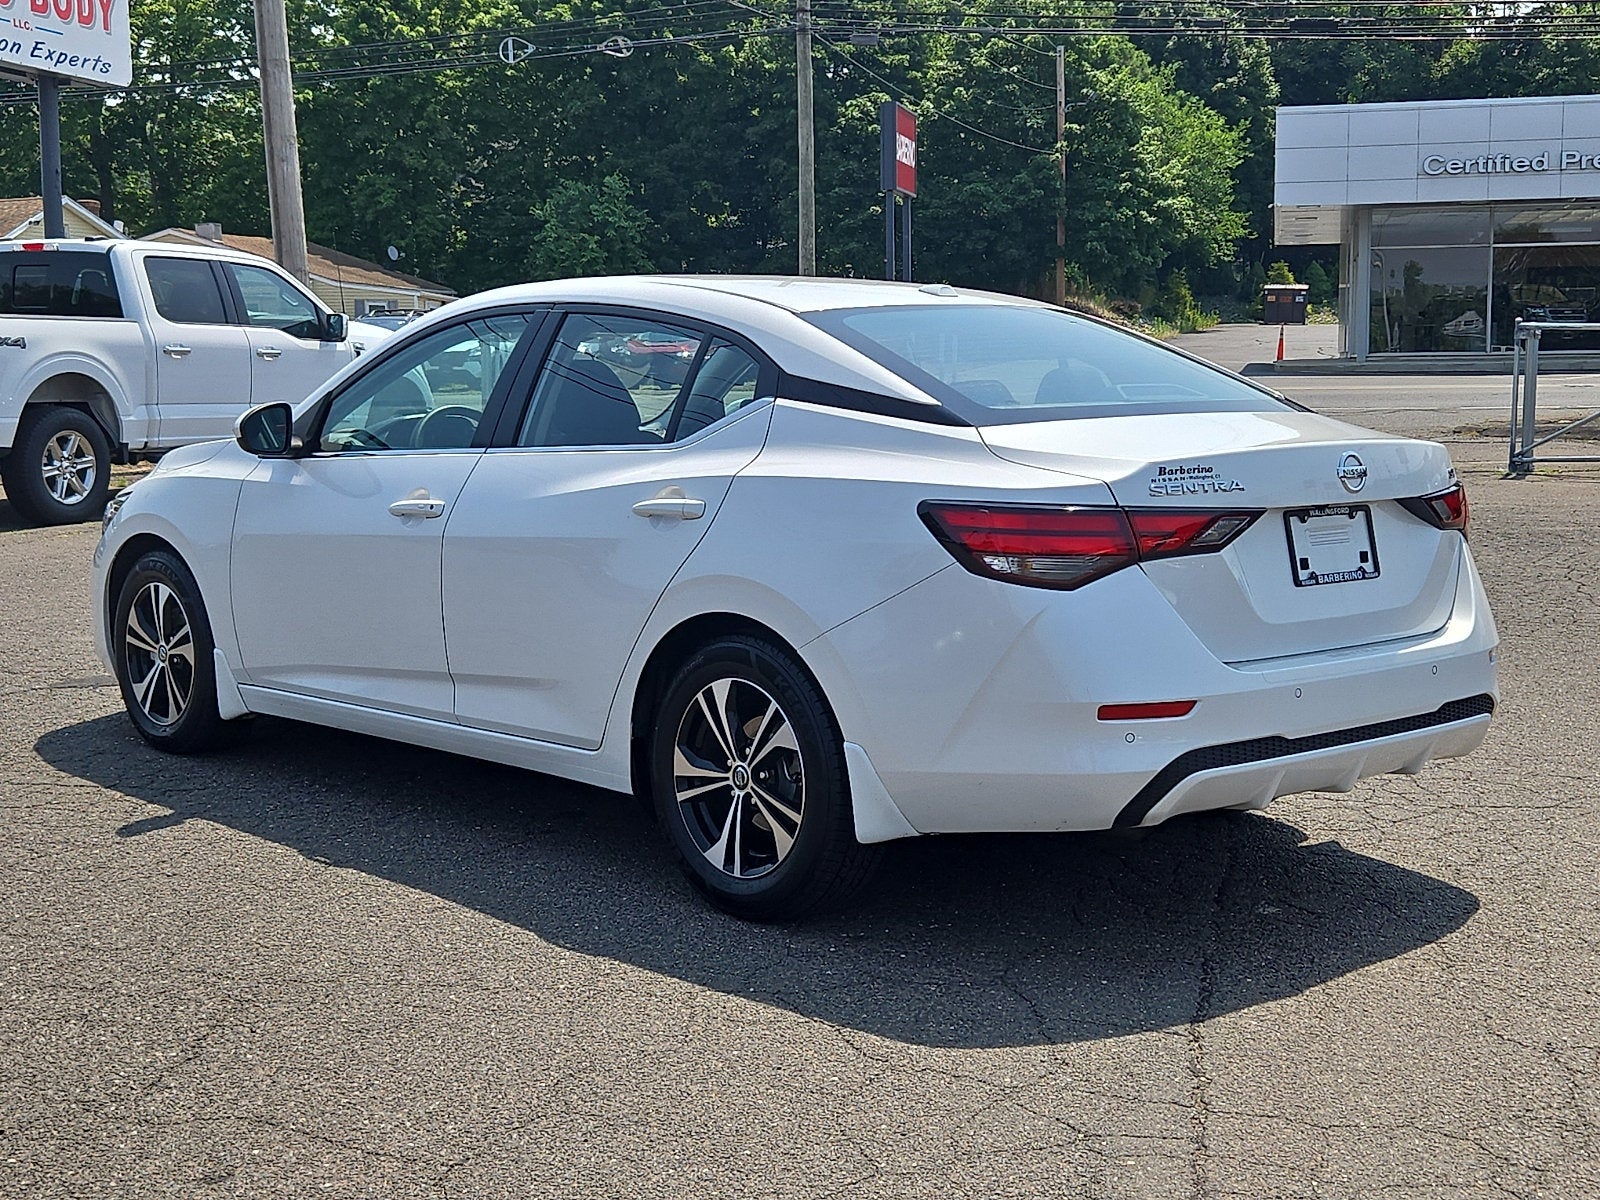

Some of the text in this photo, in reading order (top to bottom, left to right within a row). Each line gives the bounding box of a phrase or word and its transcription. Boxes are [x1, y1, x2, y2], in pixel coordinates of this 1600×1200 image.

[12, 18, 34, 32] LLC.
[30, 40, 112, 74] Experts
[1423, 151, 1549, 175] Certified
[1158, 464, 1214, 476] Barberino
[1344, 466, 1367, 478] NISSAN
[1149, 480, 1245, 497] SENTRA
[1308, 507, 1350, 517] WALLINGFORD
[1317, 570, 1363, 584] BARBERINO
